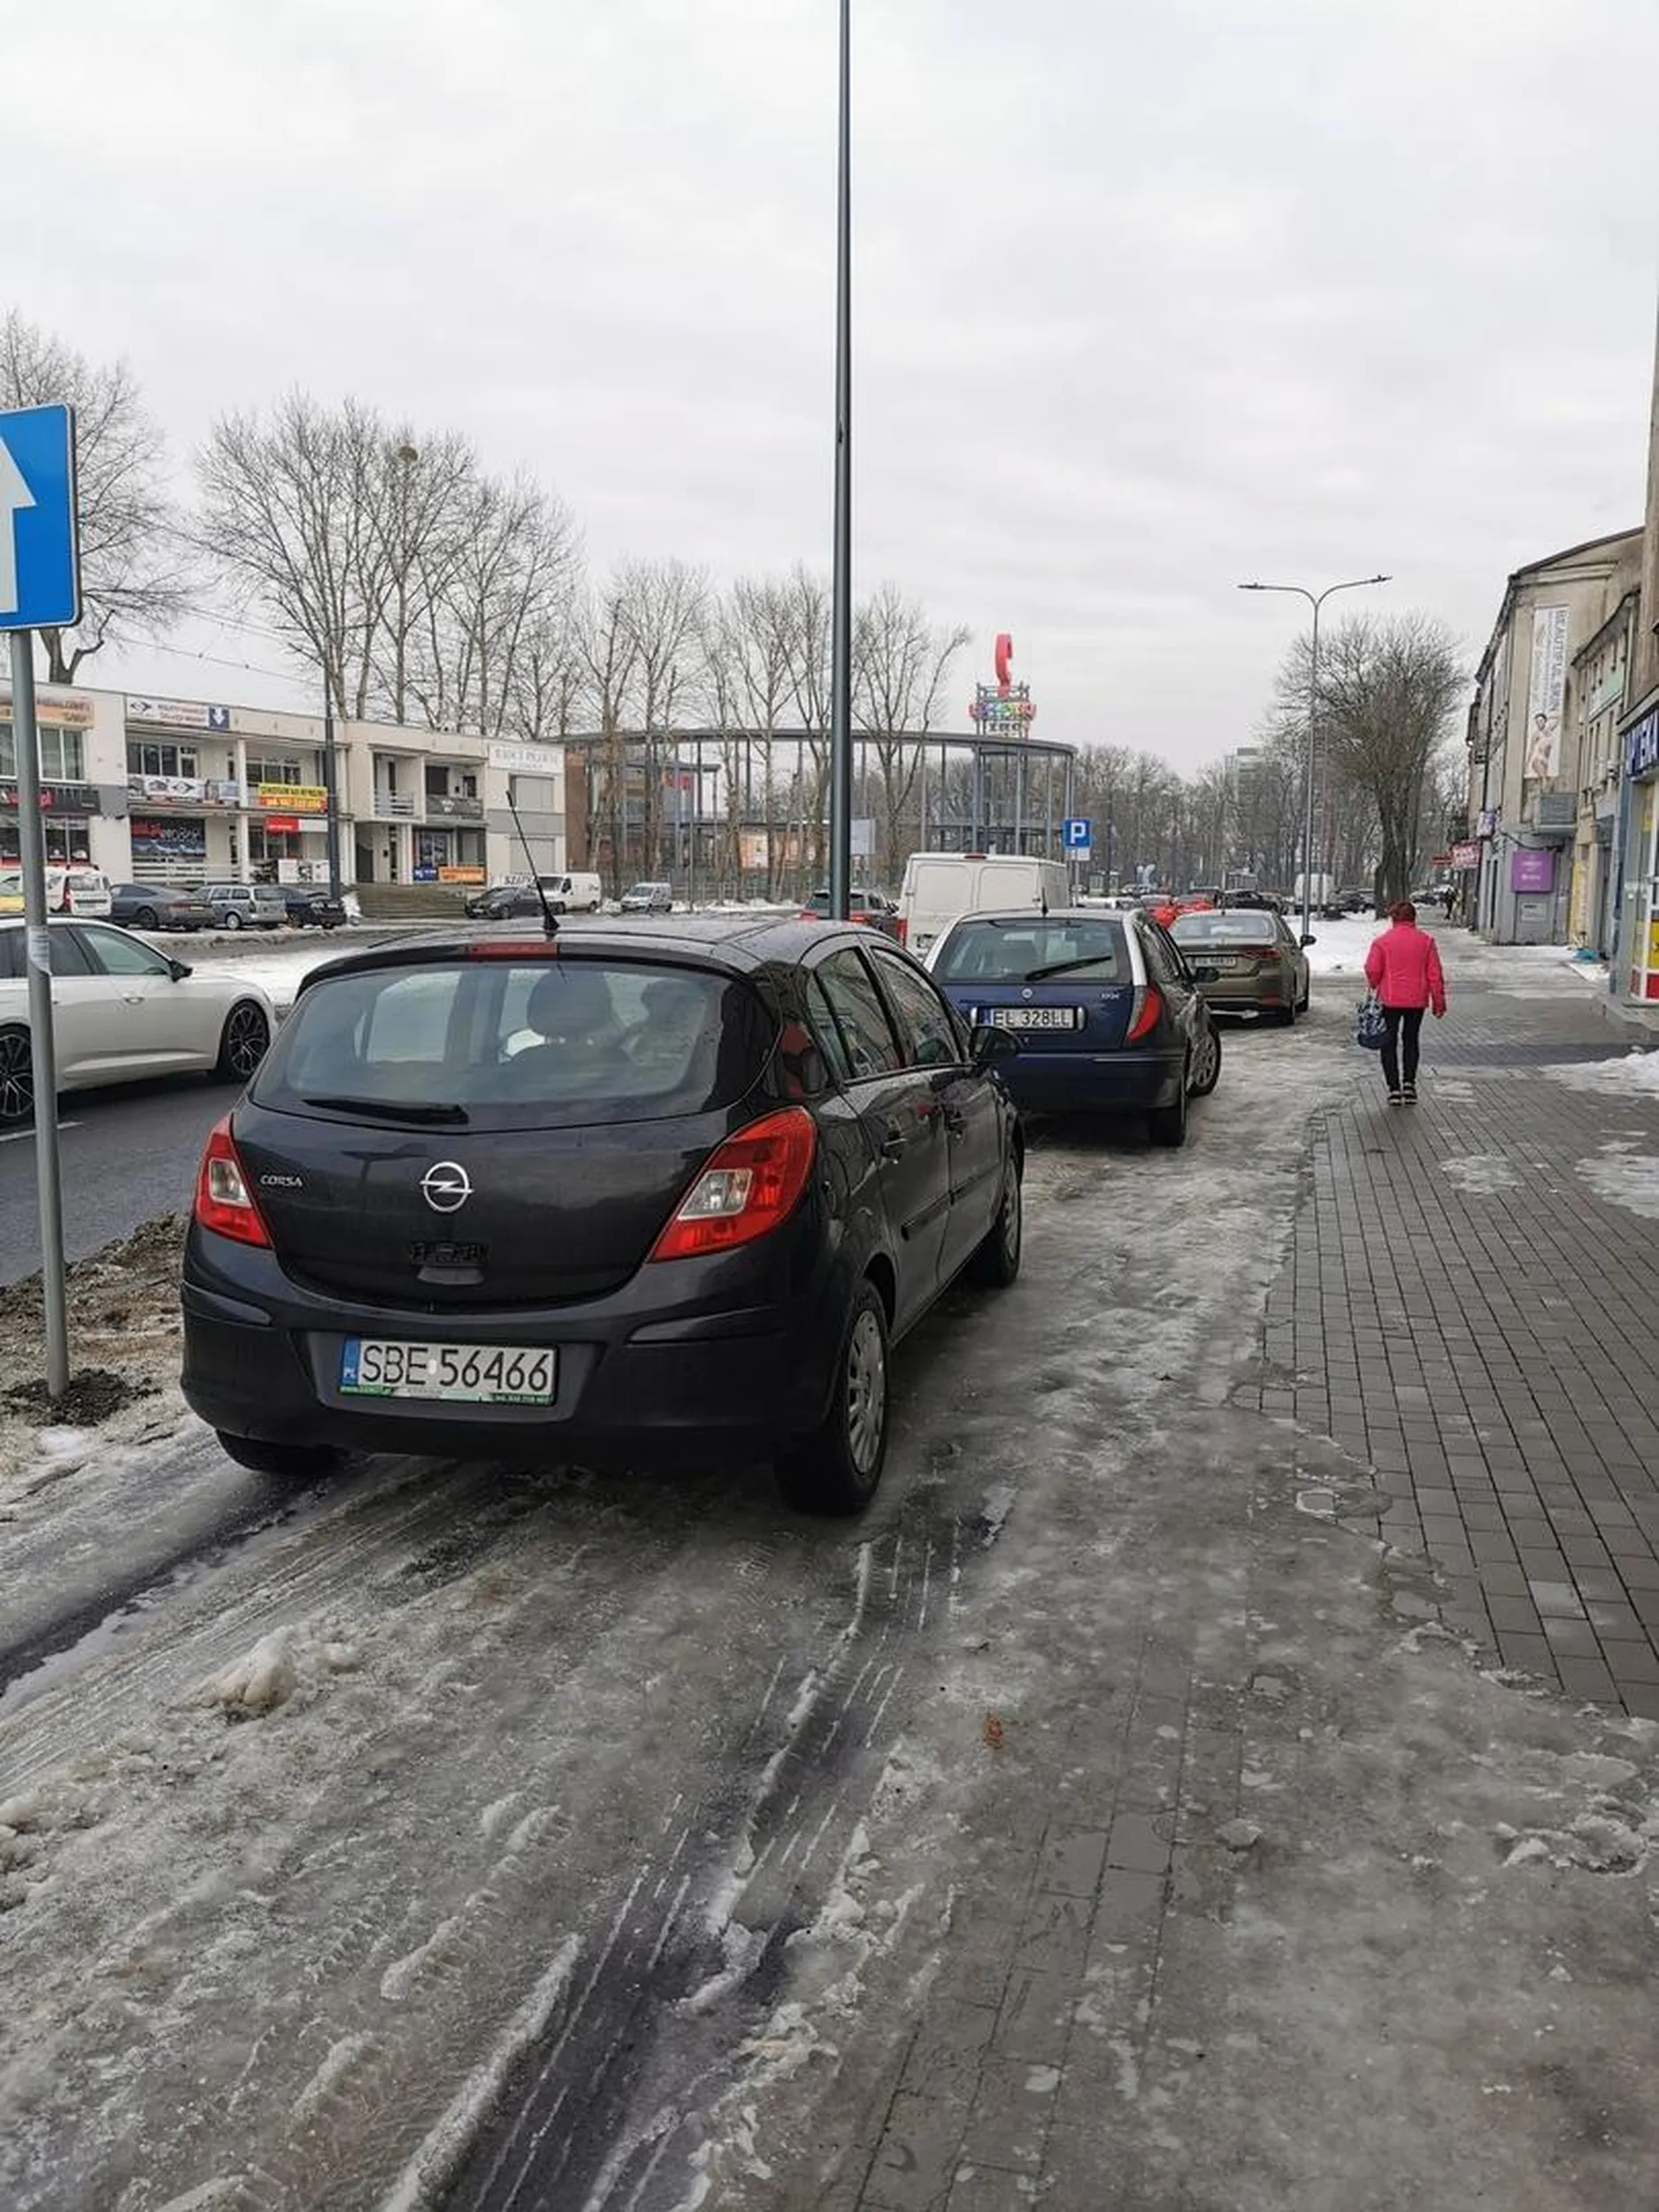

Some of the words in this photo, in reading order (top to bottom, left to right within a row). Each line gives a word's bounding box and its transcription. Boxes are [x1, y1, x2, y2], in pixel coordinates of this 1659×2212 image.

[1070, 822, 1087, 843] P
[994, 1010, 1015, 1026] EL
[260, 1175, 303, 1187] CORSA
[361, 1344, 429, 1386] SBE
[439, 1348, 550, 1392] 56466
